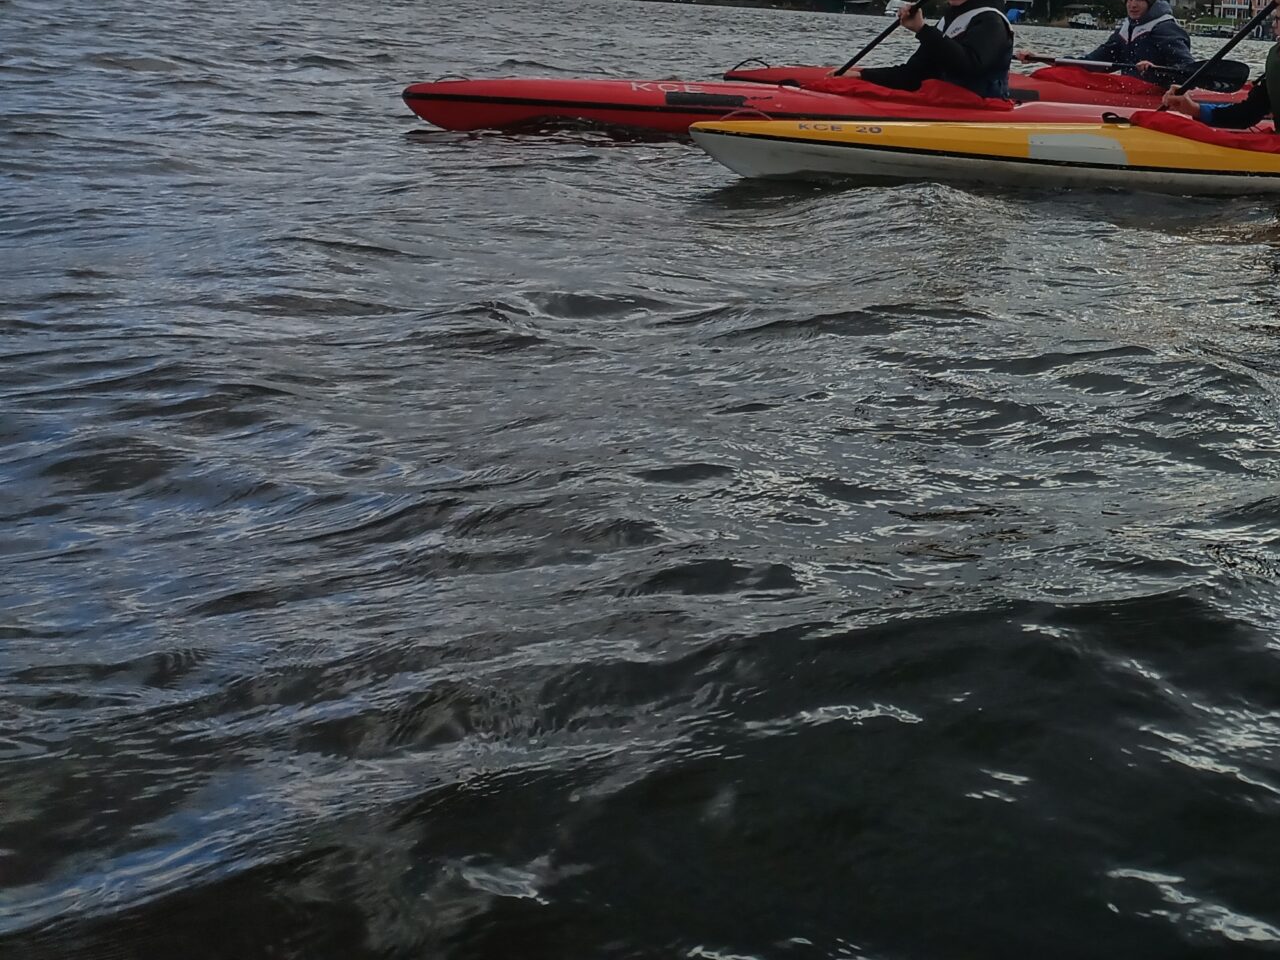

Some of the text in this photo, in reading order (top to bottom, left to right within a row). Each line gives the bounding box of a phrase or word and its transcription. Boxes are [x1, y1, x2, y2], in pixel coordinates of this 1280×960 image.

[631, 81, 705, 94] KCE
[797, 122, 882, 134] KCE 20
